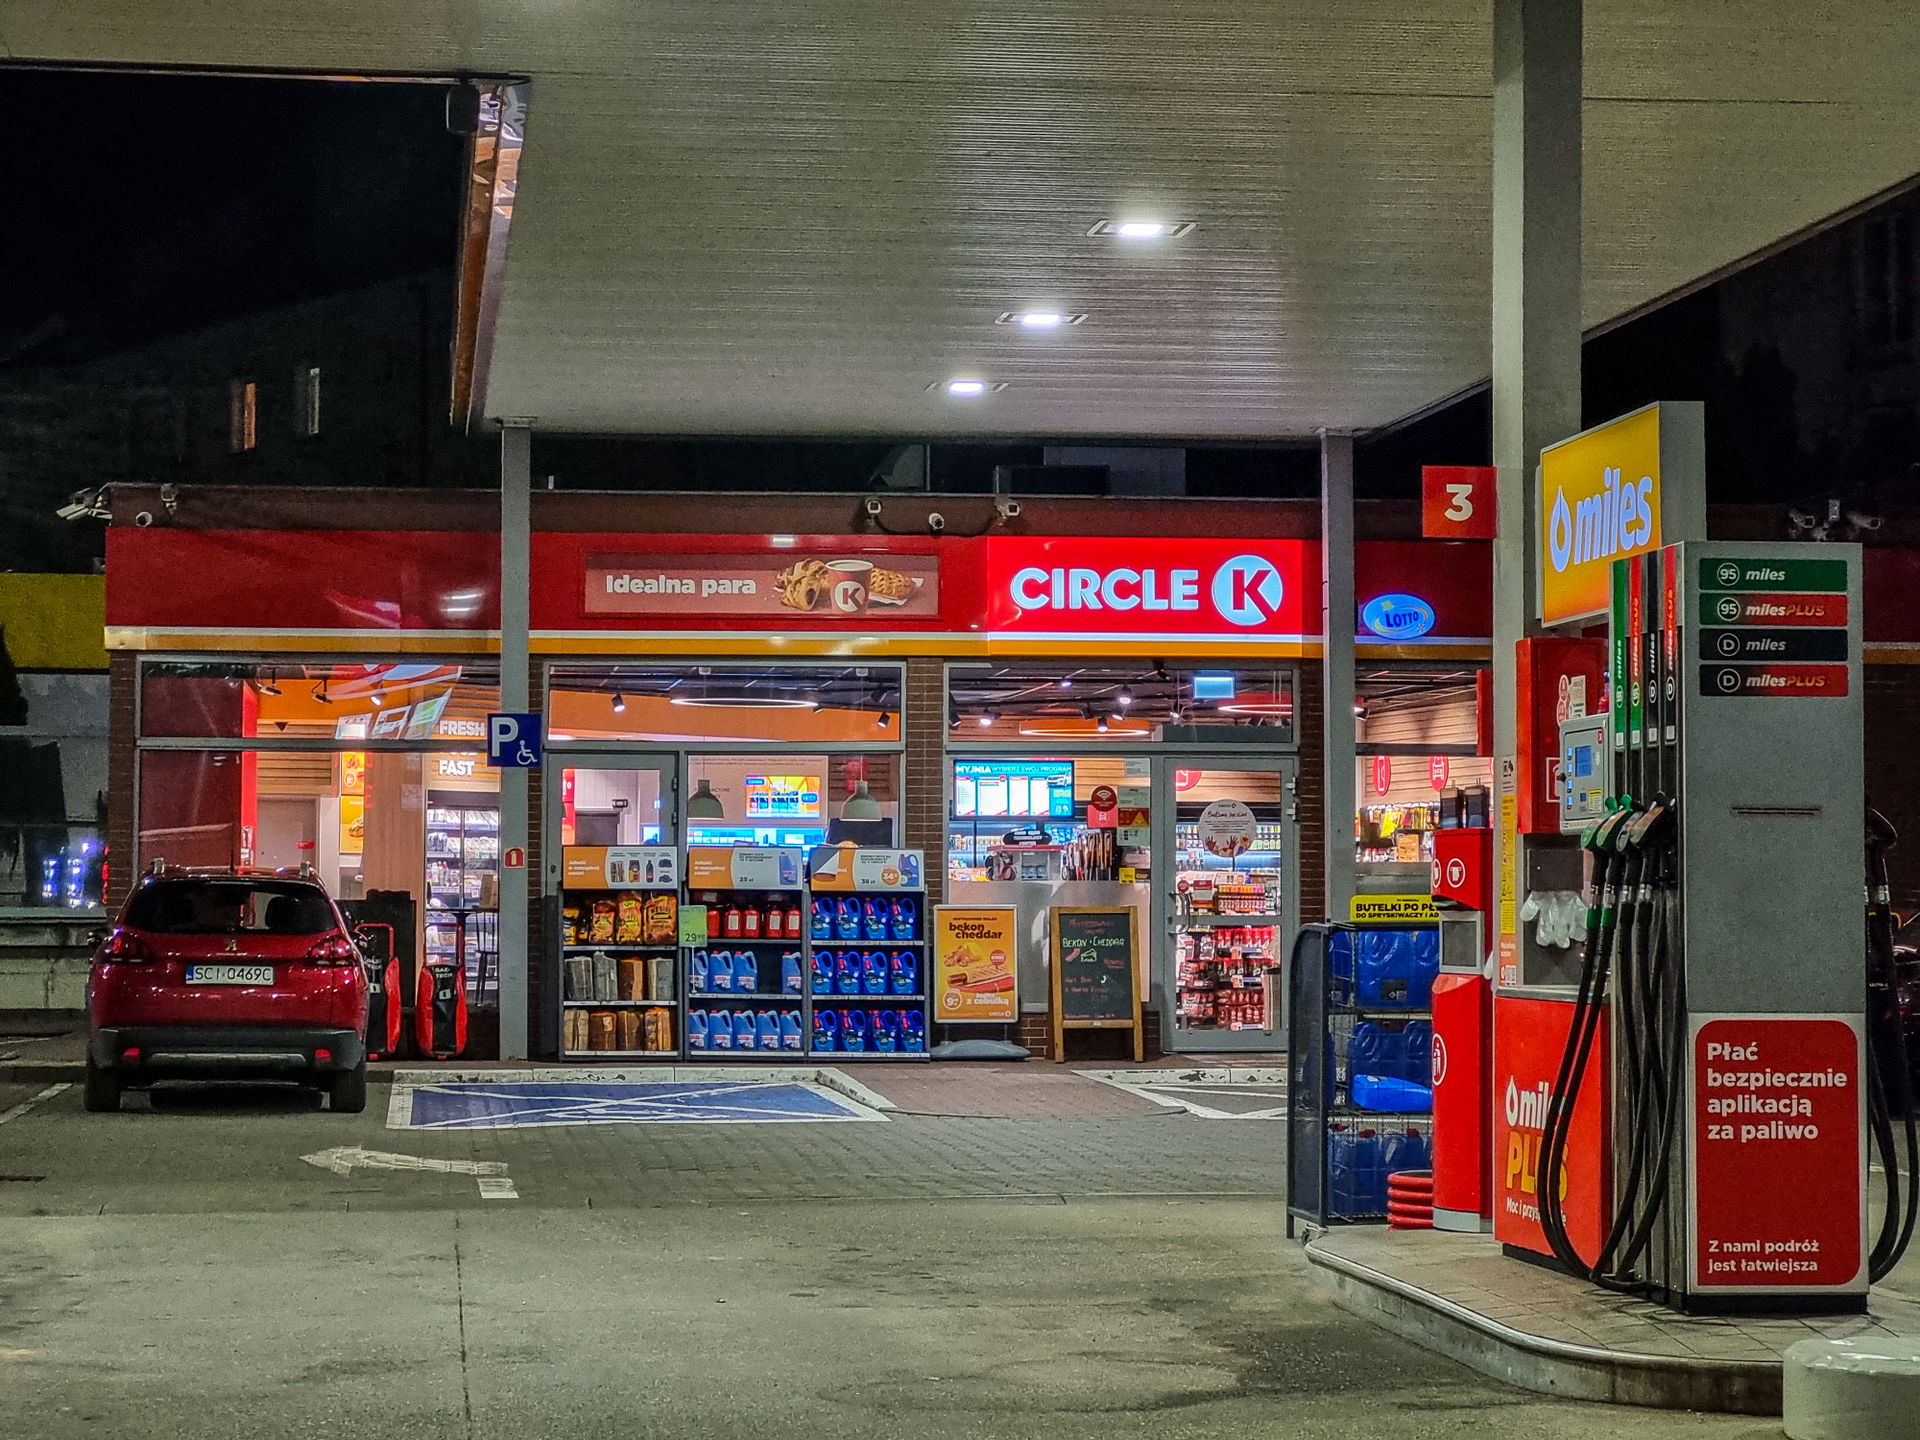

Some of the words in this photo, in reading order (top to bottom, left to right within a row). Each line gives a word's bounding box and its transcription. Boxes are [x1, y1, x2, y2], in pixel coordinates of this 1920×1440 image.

[1444, 484, 1473, 522] 3
[1574, 466, 1653, 565] miles
[1720, 568, 1737, 580] 95
[1745, 568, 1786, 581] miles
[605, 575, 696, 594] Idealna
[701, 579, 757, 598] para
[1010, 567, 1199, 610] CIRCLE
[1224, 560, 1281, 625] K
[1720, 603, 1738, 616] 95
[1745, 603, 1826, 617] milesPLUS
[1385, 611, 1419, 628] LOTTO
[1723, 639, 1735, 651] D
[1745, 638, 1787, 651] miles
[1723, 674, 1735, 686] D
[1745, 673, 1826, 687] milesPLUS
[440, 720, 485, 737] FRESH
[491, 716, 519, 758] P
[439, 759, 475, 777] FAST
[1355, 903, 1402, 912] BUTELKI
[1404, 903, 1419, 912] PO
[949, 922, 985, 932] bekon
[955, 929, 1004, 940] cheddar
[226, 967, 272, 982] 0469C
[1707, 1041, 1759, 1061] Płać
[1707, 1067, 1848, 1091] bezpiecznie
[1707, 1094, 1812, 1117] aplikacją
[1707, 1124, 1734, 1140] za
[1740, 1120, 1819, 1144] paliwo
[1708, 1239, 1720, 1253] Z
[1722, 1239, 1761, 1253] nami
[1764, 1238, 1820, 1255] podróż
[1708, 1258, 1737, 1274] jest
[1740, 1258, 1819, 1275] łatwiejsza
